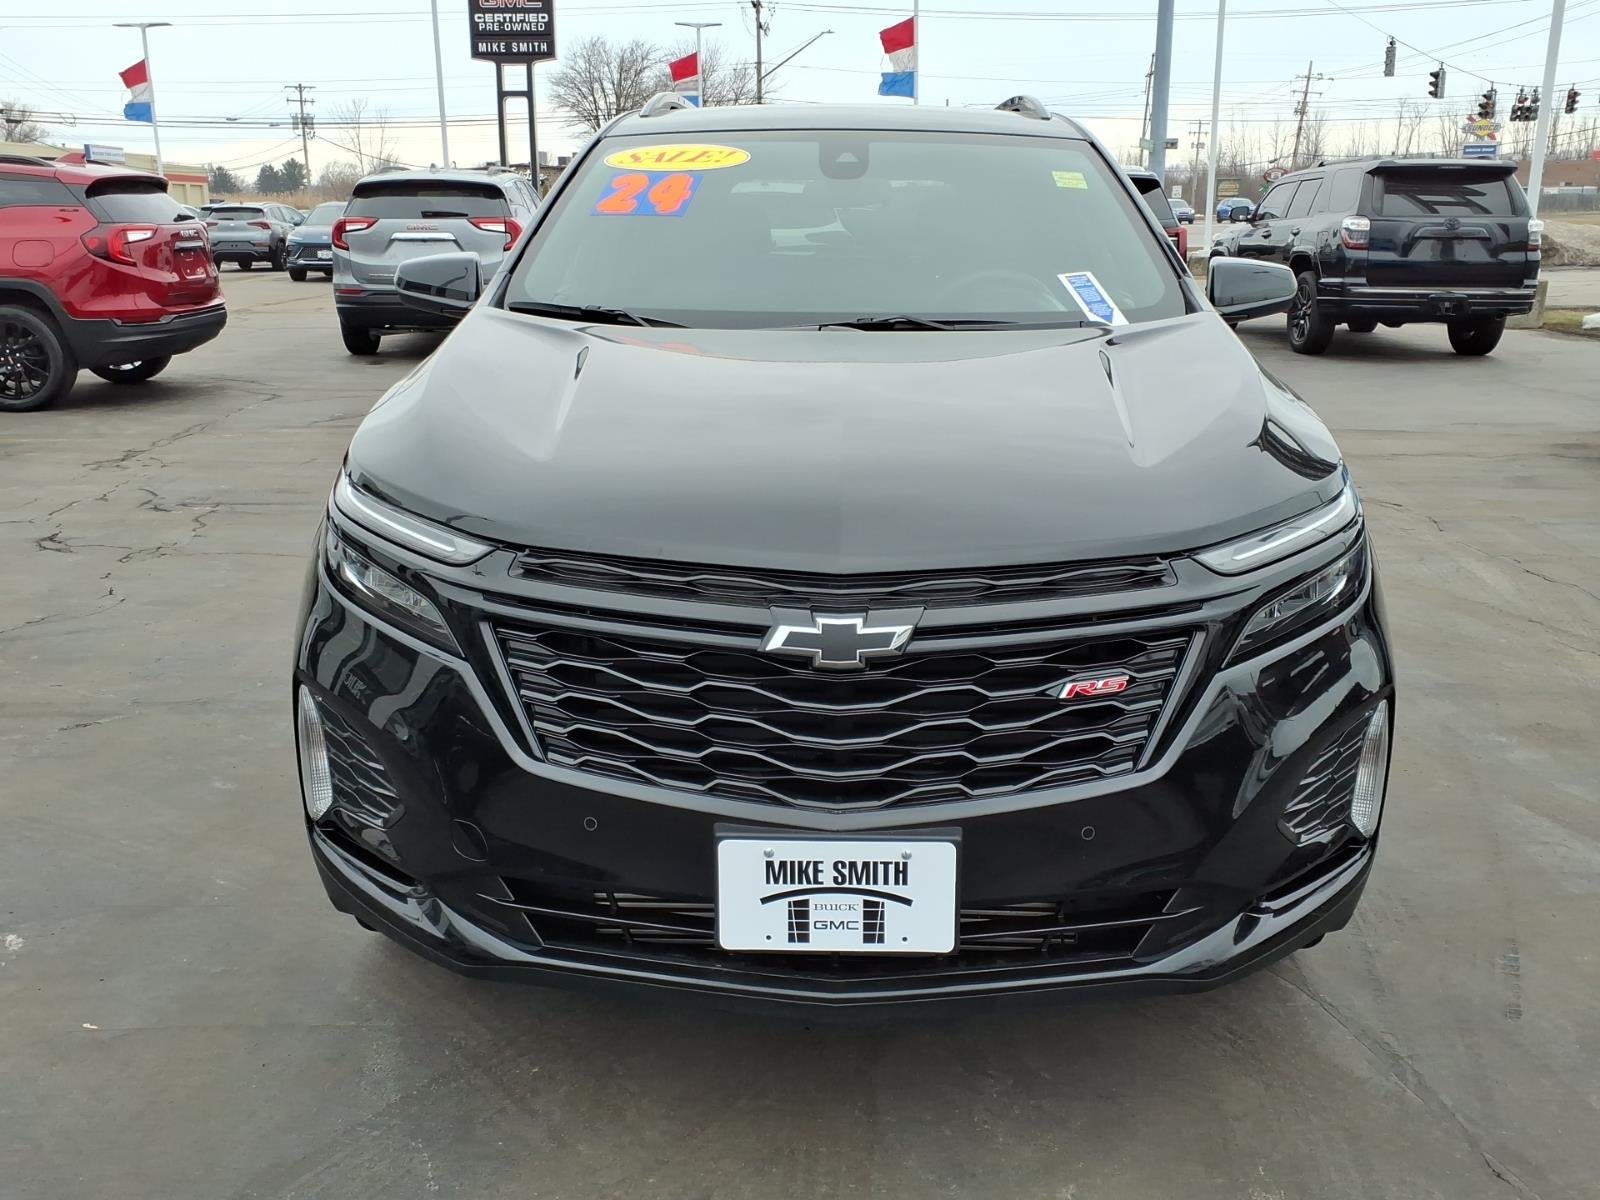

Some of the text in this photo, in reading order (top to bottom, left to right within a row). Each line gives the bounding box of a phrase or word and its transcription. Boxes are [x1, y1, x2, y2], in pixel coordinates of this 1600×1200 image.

[479, 0, 542, 8] GMC
[474, 13, 549, 22] CERTIFIED
[479, 22, 545, 31] PRE-OWNED
[478, 42, 547, 53] MIKE SMITH
[1468, 123, 1500, 133] SUNOCO
[596, 173, 693, 214] 24
[1060, 676, 1129, 698] RS
[765, 860, 908, 886] MIKE SMITH
[814, 904, 858, 912] BUICK
[813, 921, 859, 930] GMC
